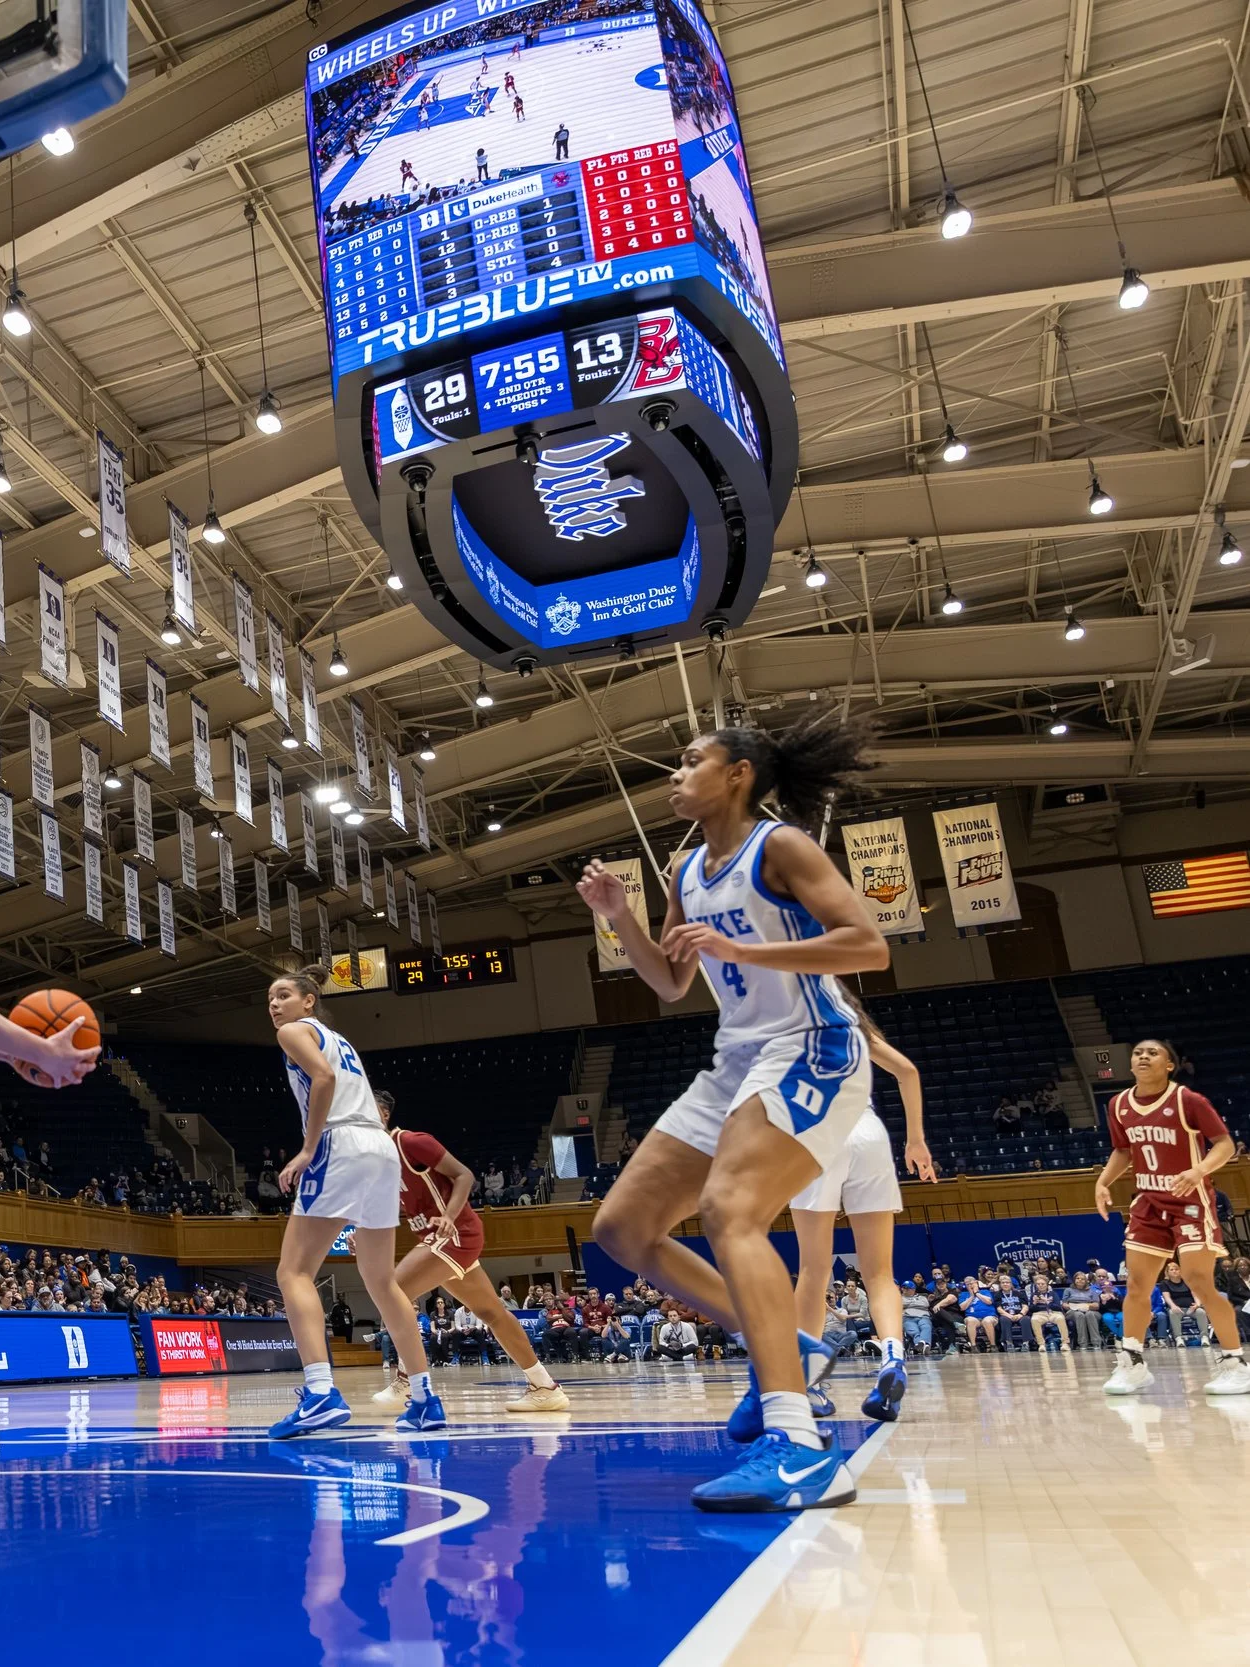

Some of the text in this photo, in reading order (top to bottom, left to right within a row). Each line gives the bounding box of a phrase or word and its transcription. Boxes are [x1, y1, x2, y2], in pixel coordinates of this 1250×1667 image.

[601, 14, 639, 30] DUKE
[310, 46, 326, 60] CC
[316, 8, 457, 84] WHEELS UP
[586, 142, 676, 171] PL PTS REB FLS
[594, 160, 674, 187] 0 0 0 0
[597, 177, 677, 203] 1 0 1 0
[441, 198, 552, 241] 1 O-REB 1
[329, 221, 402, 259] PL PTS REB FLS
[438, 212, 553, 256] 12 D-REB 7
[444, 226, 557, 269] 1 BLK 0
[446, 241, 558, 284] 2 STL 0
[448, 256, 562, 299] 3 TO 4
[572, 332, 623, 370] 13
[479, 346, 560, 388] 7:55
[578, 366, 621, 382] Fouls: 1
[424, 373, 467, 412] 29
[484, 383, 564, 410] 4 TIMEOUTS 3
[499, 377, 546, 396] 2ND QTR
[432, 407, 471, 426] Fouls: 1
[511, 400, 539, 413] POSS
[106, 480, 124, 514] 35
[534, 431, 646, 541] Duke
[586, 585, 677, 610] Washington Duke
[592, 596, 673, 621] Inn & Golf Club
[945, 819, 992, 834] NATIONAL
[853, 832, 898, 848] NATIONAL
[942, 830, 1000, 847] CHAMPIONS
[851, 844, 905, 860] CHAMPIONS
[970, 852, 1002, 869] FINAL
[863, 875, 905, 892] FOUR
[874, 866, 904, 878] FINAL
[960, 862, 1002, 885] FOUR
[971, 897, 1000, 911] 2015
[687, 908, 753, 938] KE
[877, 910, 905, 923] 2010
[400, 961, 422, 969] DUKE
[442, 954, 468, 967] 7:55
[407, 961, 502, 984] 29 13
[722, 962, 747, 997] 4
[338, 1039, 362, 1076] 12
[1142, 1145, 1159, 1171] 0
[1136, 1172, 1179, 1192] COLLEG
[157, 1332, 204, 1348] FAN WORK
[226, 1340, 237, 1350] Over
[160, 1350, 206, 1360] IS THIRSTY WORK
